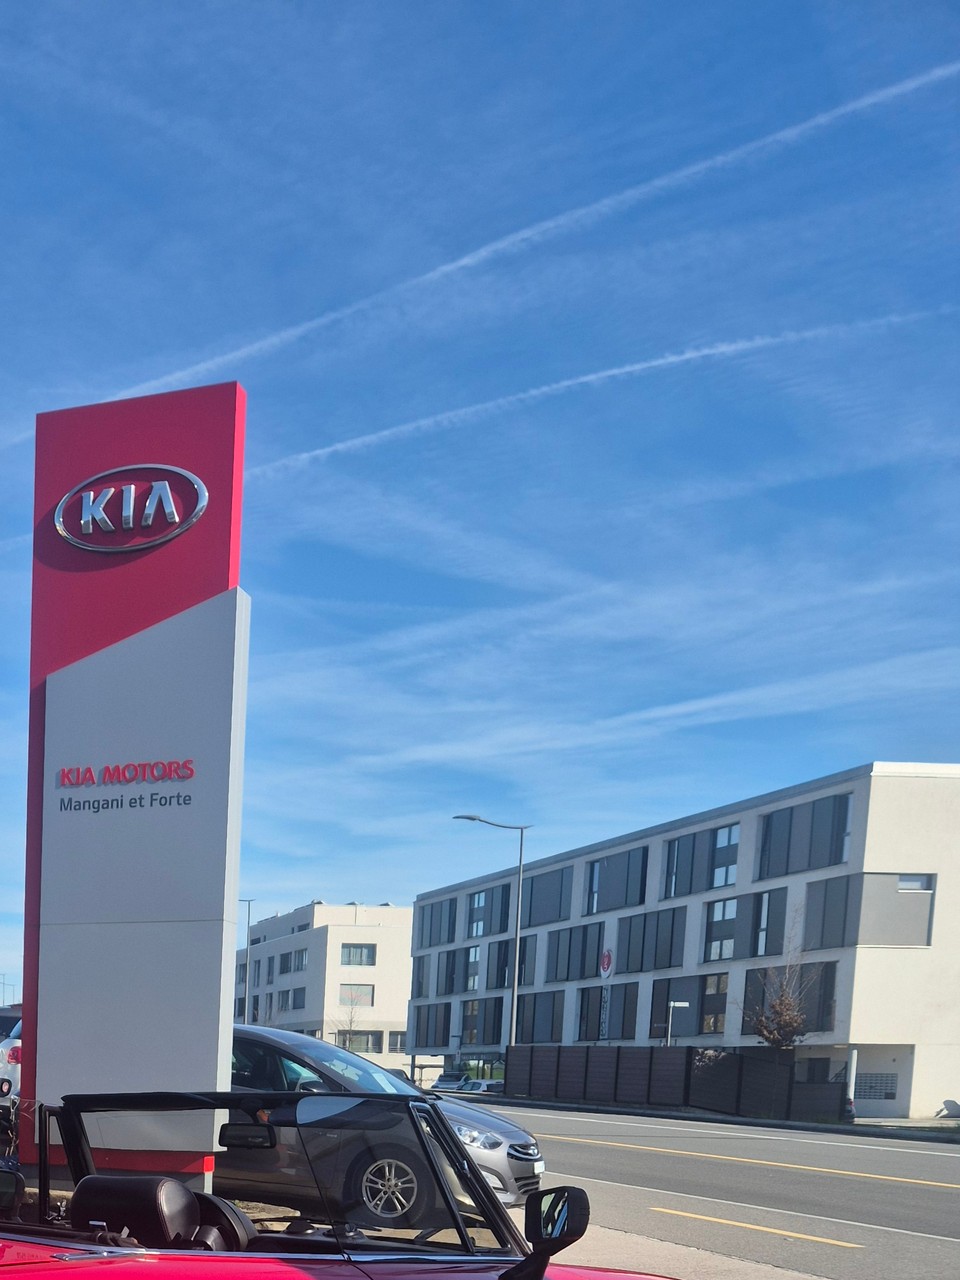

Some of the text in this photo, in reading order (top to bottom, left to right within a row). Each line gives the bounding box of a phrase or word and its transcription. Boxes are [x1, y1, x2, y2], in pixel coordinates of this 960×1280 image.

[80, 480, 180, 534] KIA
[60, 759, 196, 787] KIA MOTORS
[59, 792, 192, 813] Mangani et Forte
